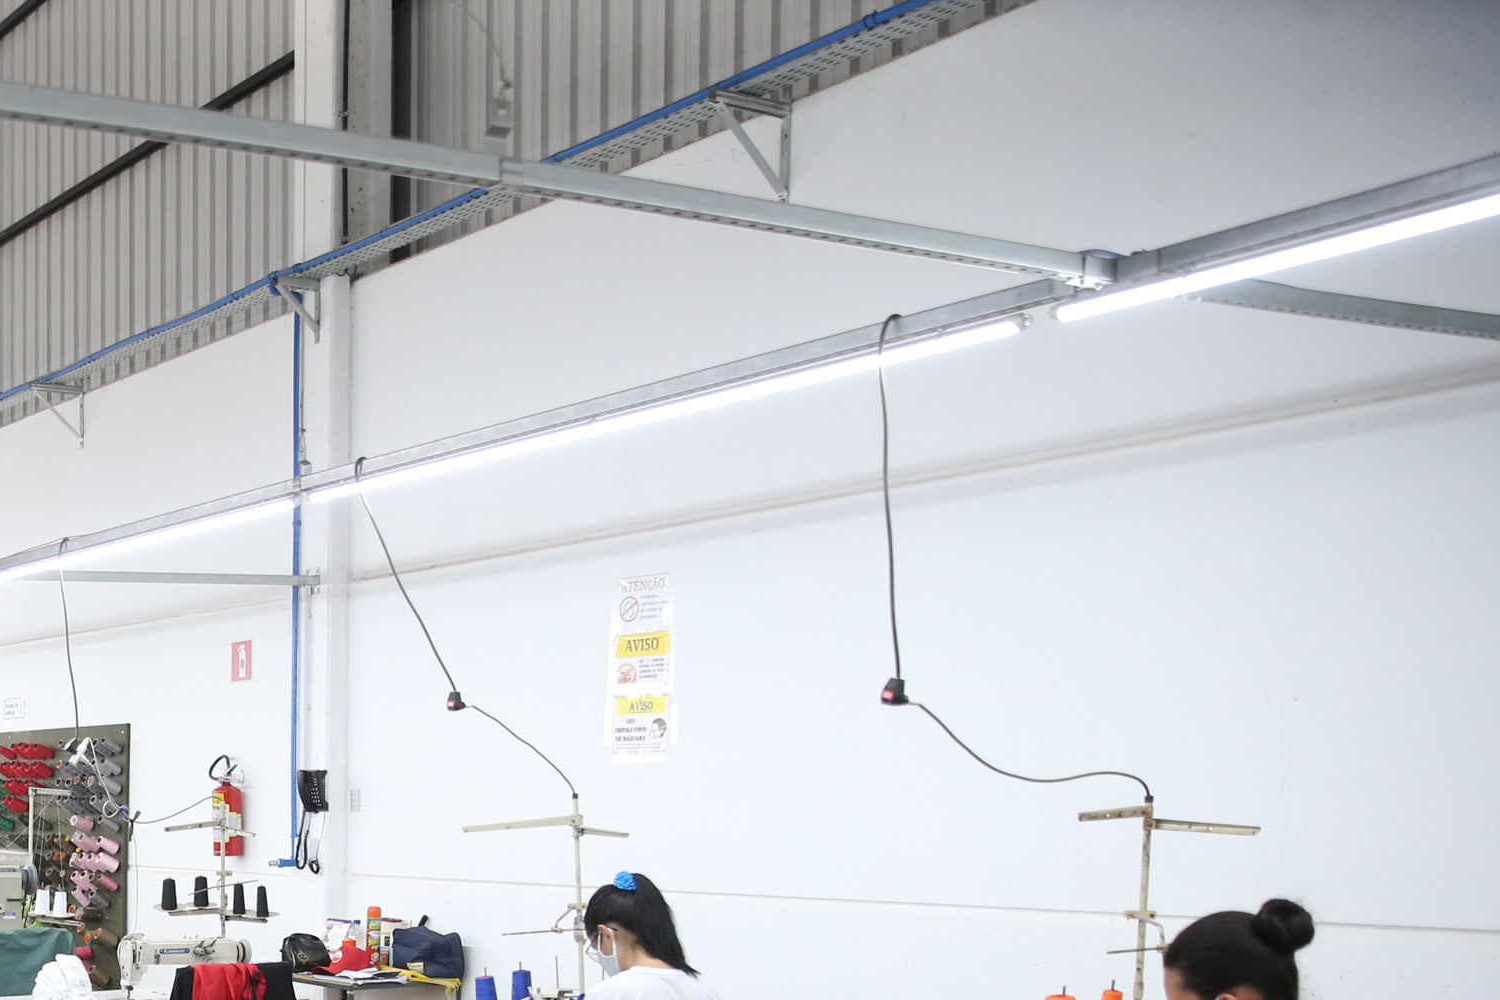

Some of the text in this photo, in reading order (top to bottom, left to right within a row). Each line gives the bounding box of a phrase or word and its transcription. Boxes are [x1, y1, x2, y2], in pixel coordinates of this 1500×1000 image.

[621, 577, 665, 593] ATENÇÃO
[625, 637, 659, 653] AVISO
[629, 701, 653, 711] AVISO
